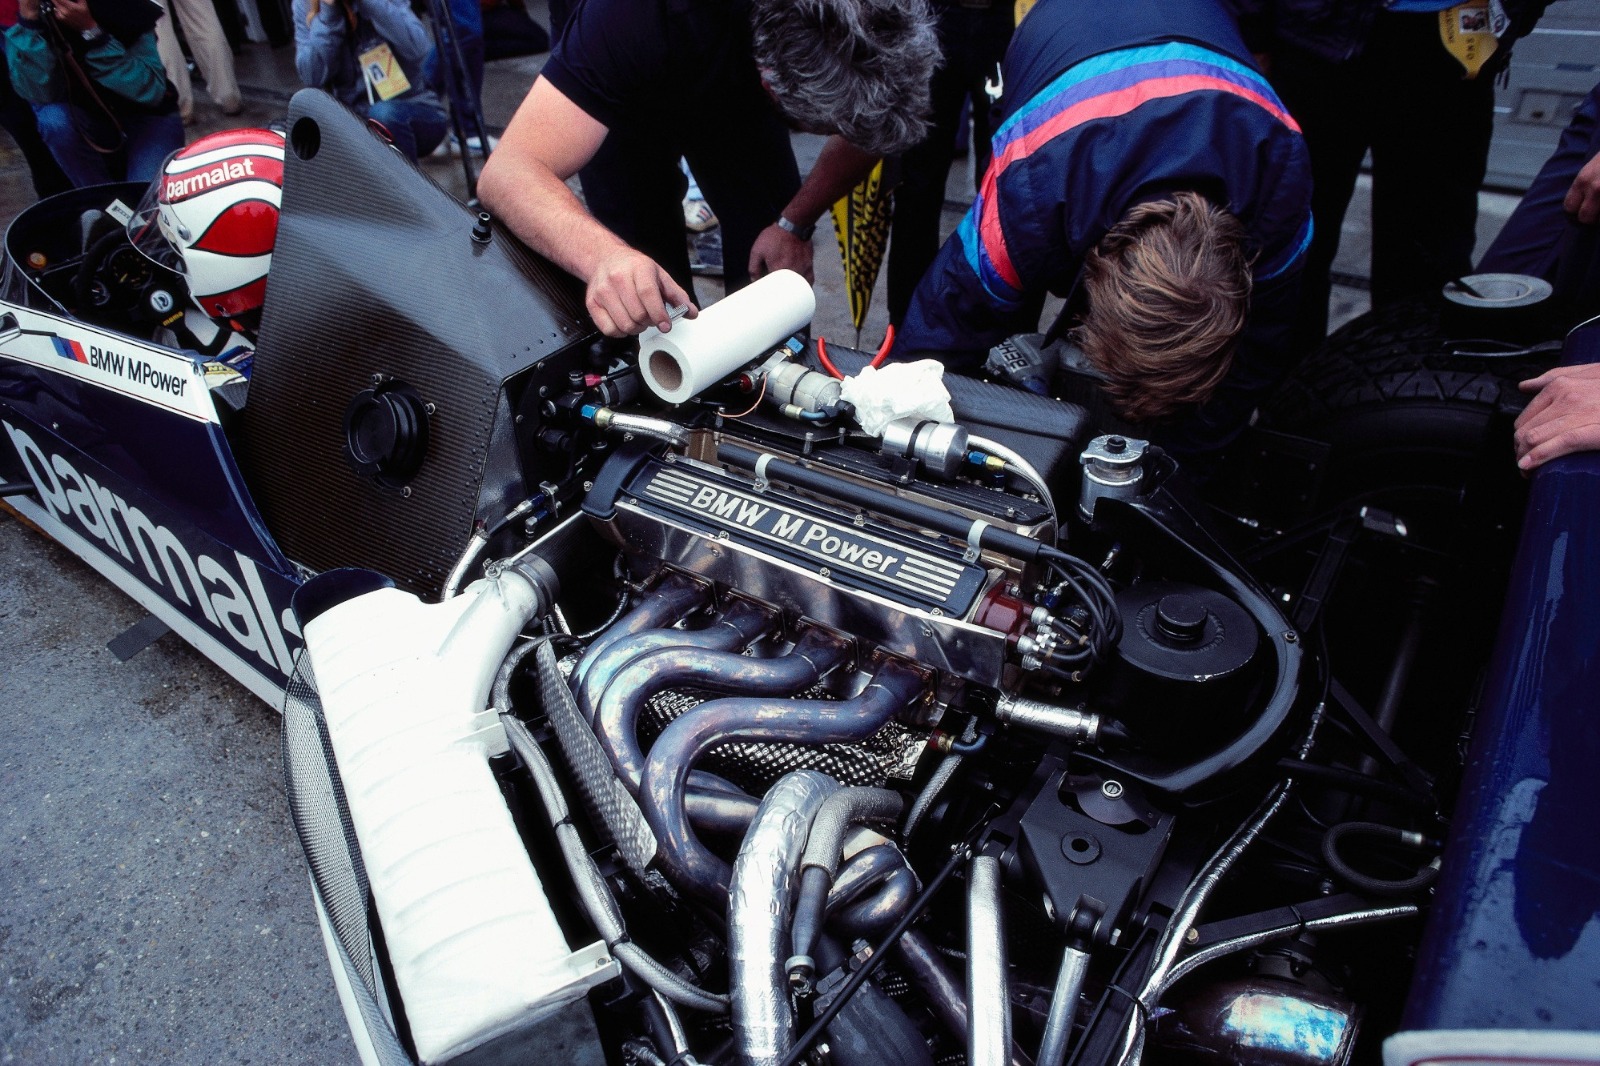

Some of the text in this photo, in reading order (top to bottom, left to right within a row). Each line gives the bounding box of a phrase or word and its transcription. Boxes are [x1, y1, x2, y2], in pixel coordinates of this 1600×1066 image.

[166, 158, 255, 199] parmalat
[90, 345, 125, 377] BMW
[691, 486, 770, 528] BMW
[1, 419, 304, 685] parmal
